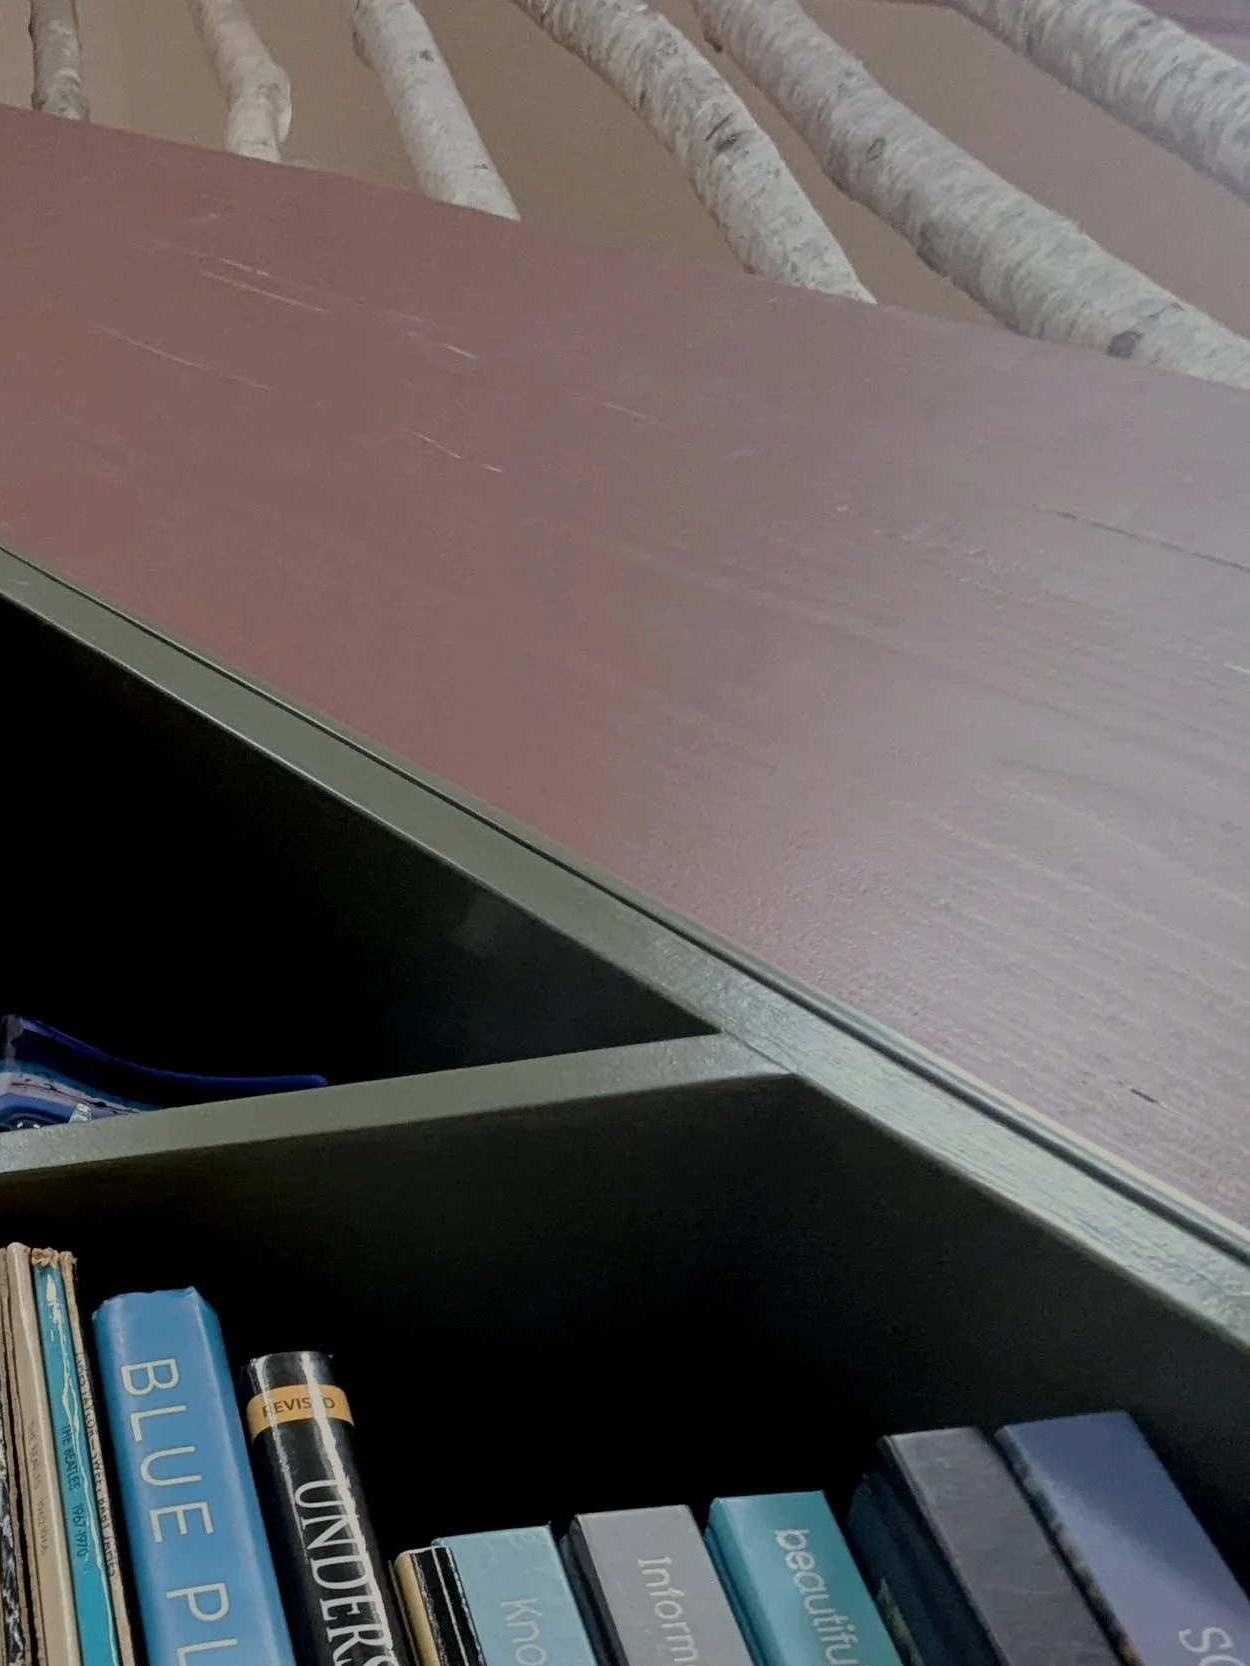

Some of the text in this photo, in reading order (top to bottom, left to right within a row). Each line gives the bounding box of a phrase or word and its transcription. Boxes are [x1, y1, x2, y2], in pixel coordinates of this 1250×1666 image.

[121, 1358, 214, 1543] BLUE
[261, 1394, 336, 1419] REVISD
[30, 1445, 43, 1490] BEATLES
[61, 1424, 89, 1558] THE BEATLES 1967-1970
